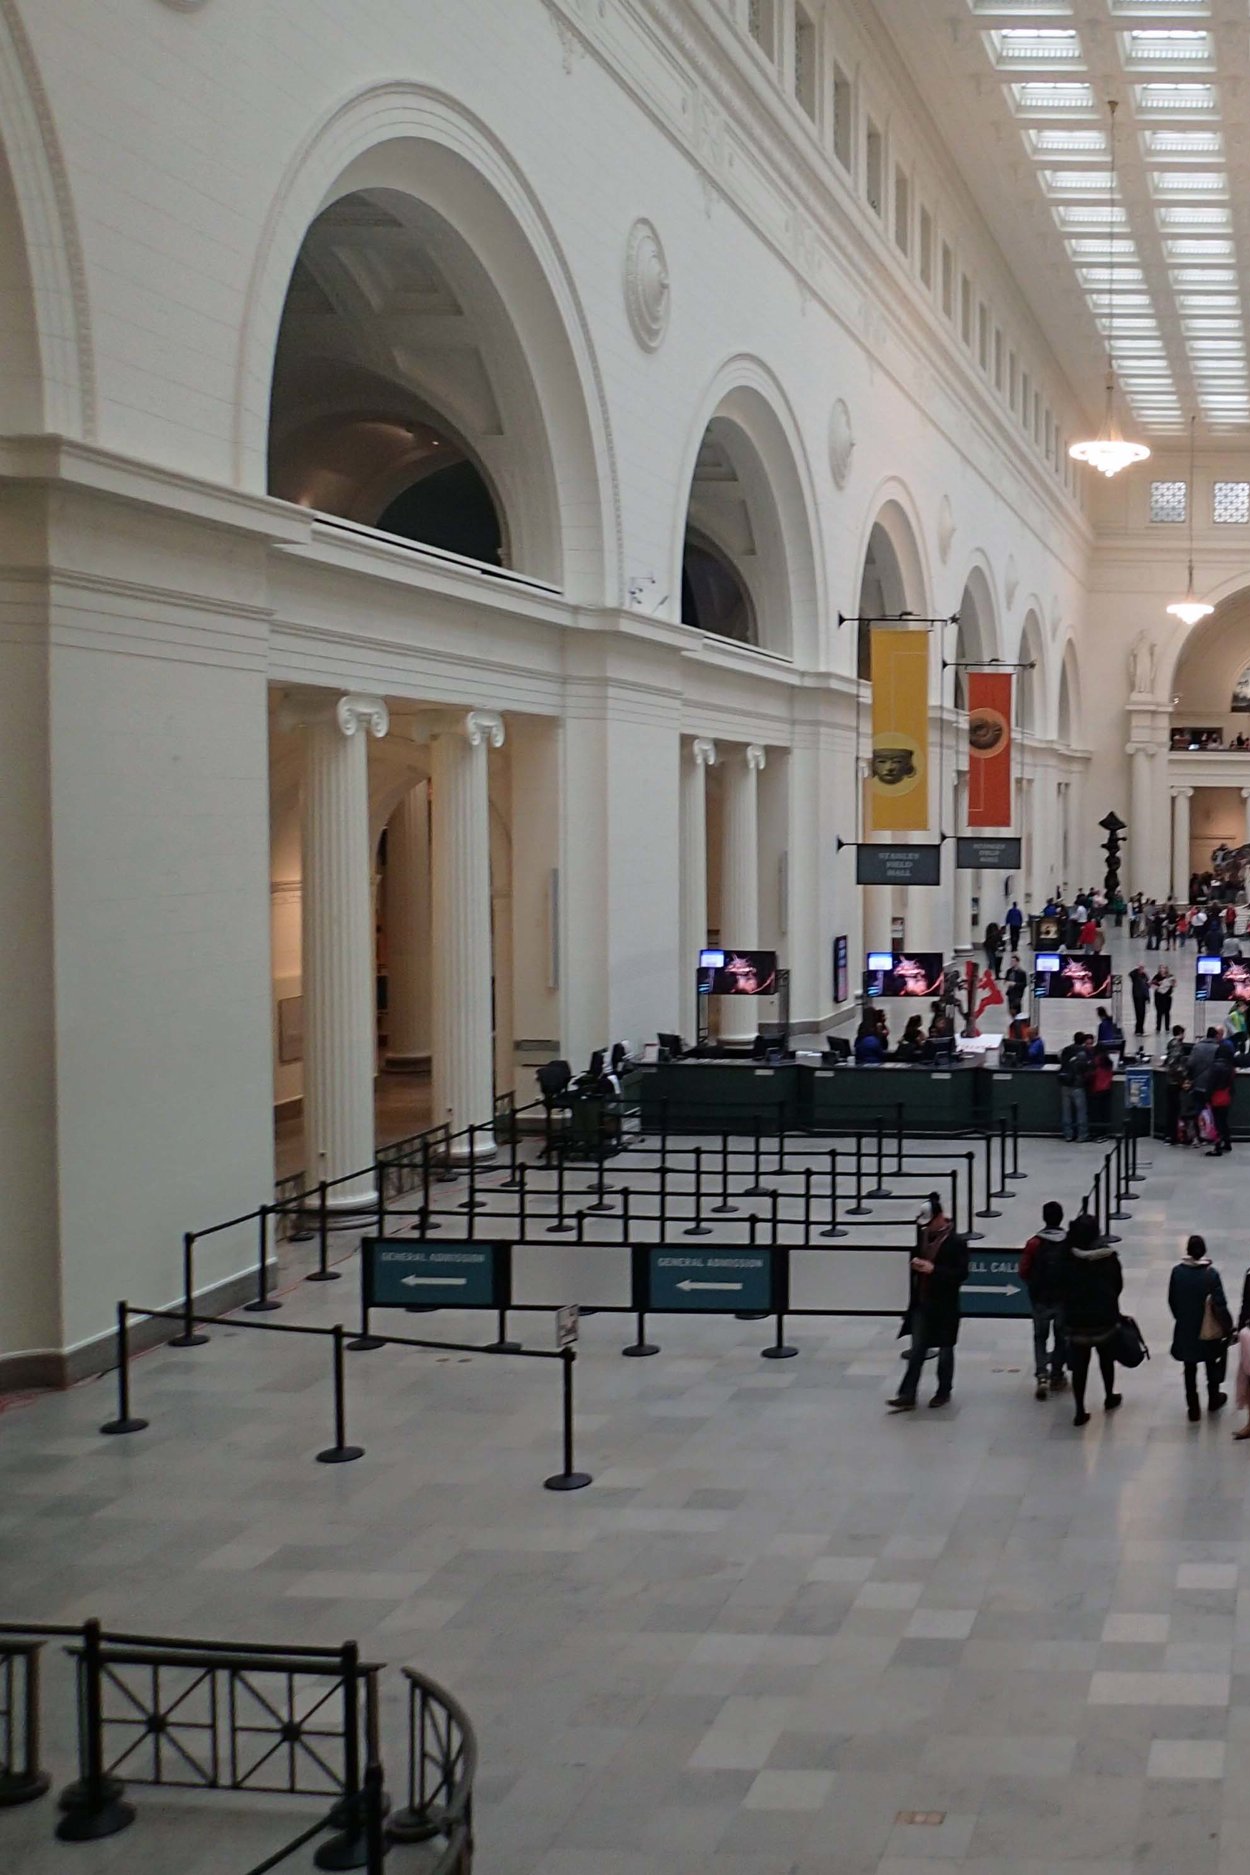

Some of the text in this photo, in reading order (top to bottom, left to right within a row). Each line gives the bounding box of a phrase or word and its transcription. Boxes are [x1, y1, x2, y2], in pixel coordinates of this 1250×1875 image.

[382, 1252, 486, 1262] GENERAL ADMISSION
[657, 1257, 763, 1268] GENERAL ADMISSION
